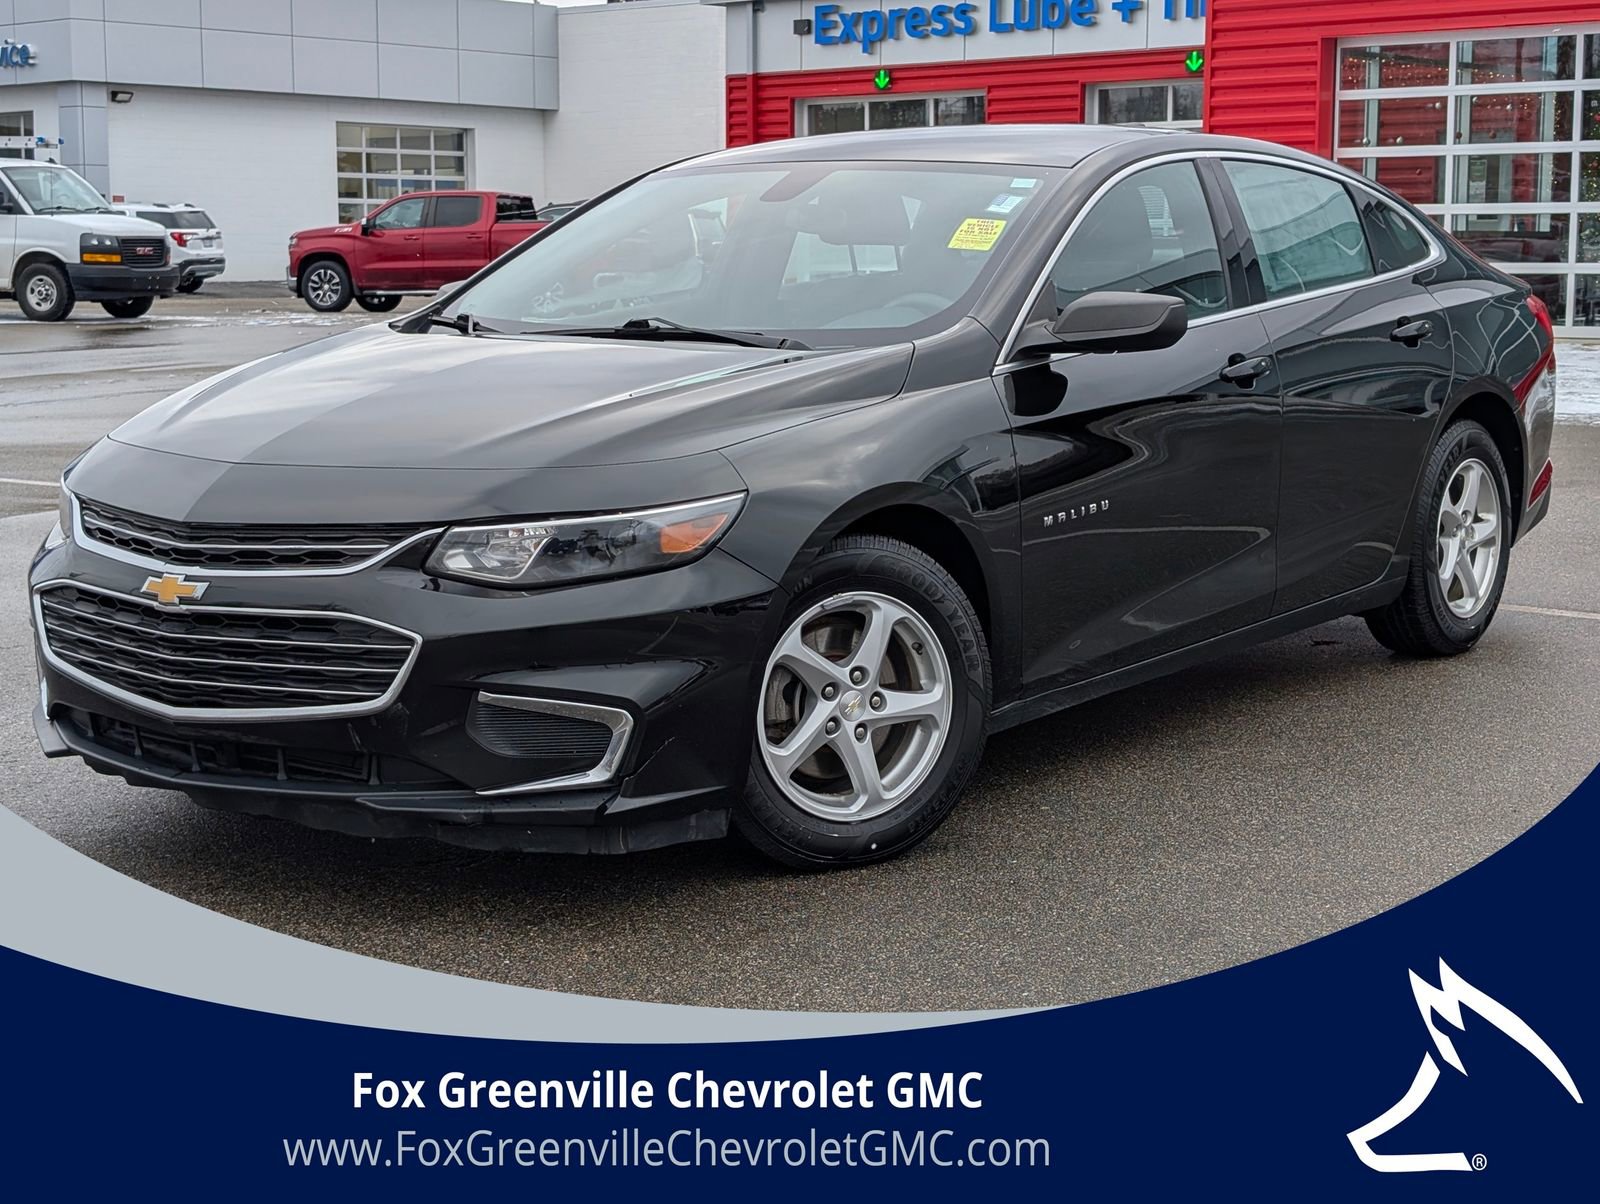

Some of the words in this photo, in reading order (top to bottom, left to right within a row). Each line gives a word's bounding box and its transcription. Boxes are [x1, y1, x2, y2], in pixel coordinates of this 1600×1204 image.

[814, 2, 979, 54] Express
[989, 0, 1098, 33] Lube
[1043, 499, 1109, 528] MALIBU
